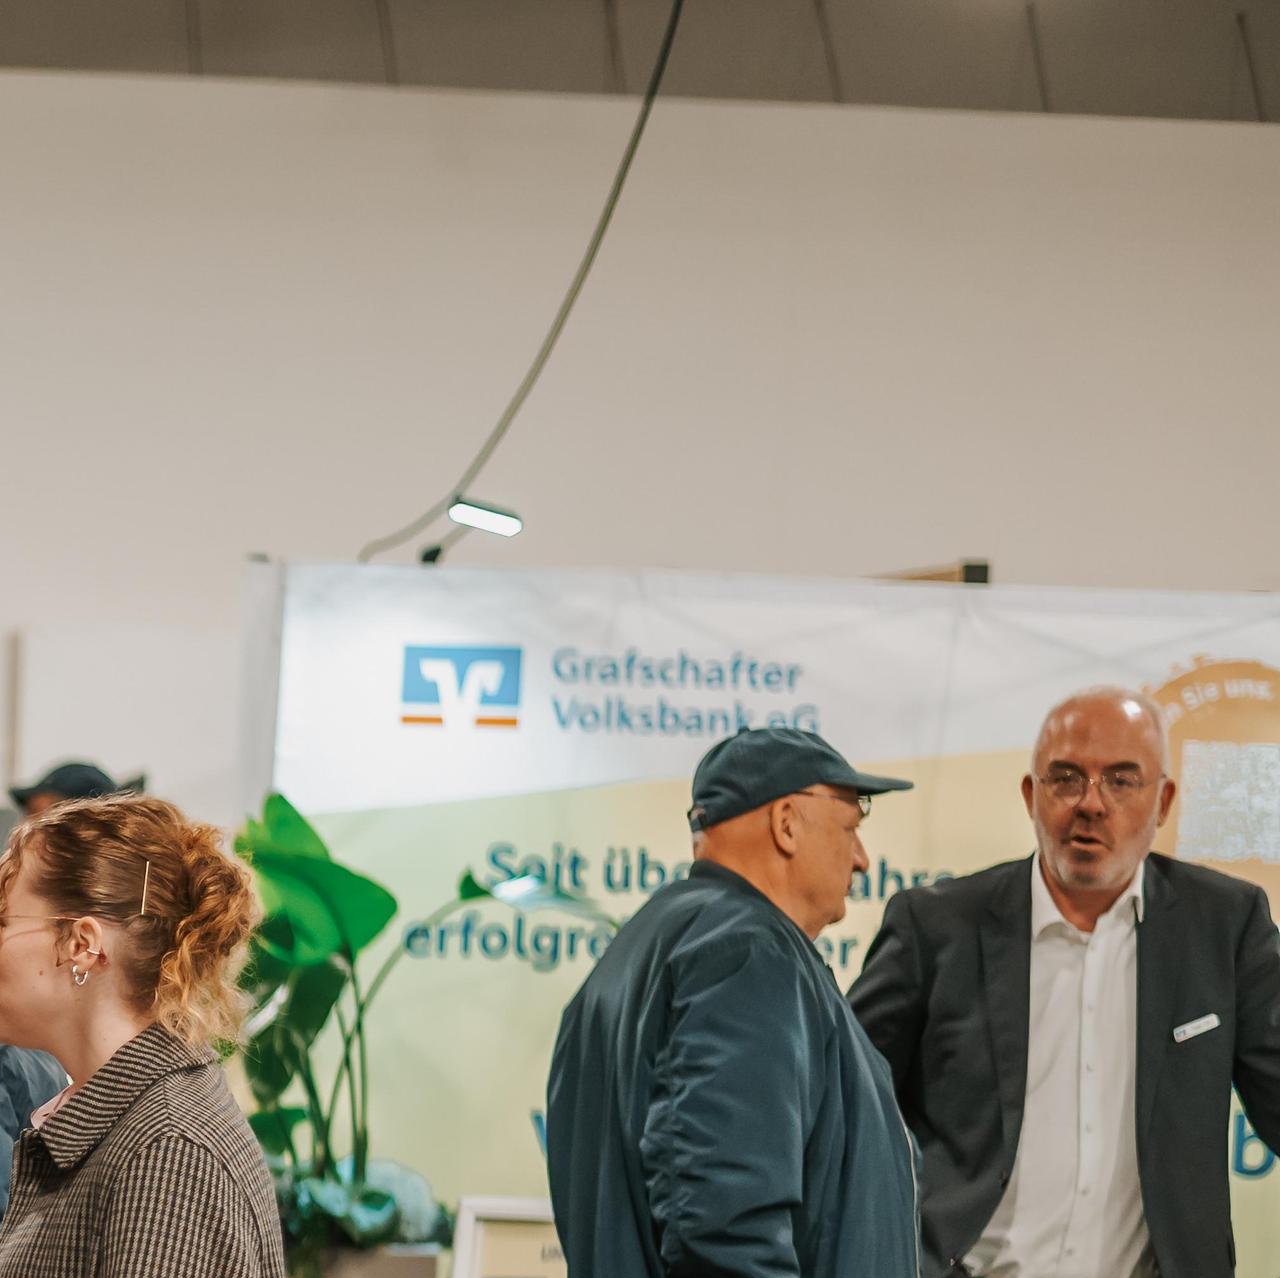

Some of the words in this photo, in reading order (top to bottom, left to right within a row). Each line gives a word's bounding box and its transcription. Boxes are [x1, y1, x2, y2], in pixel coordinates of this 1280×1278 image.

[550, 648, 805, 691] Grafschafter
[550, 696, 751, 735] Volksbank
[486, 842, 587, 894] Seit
